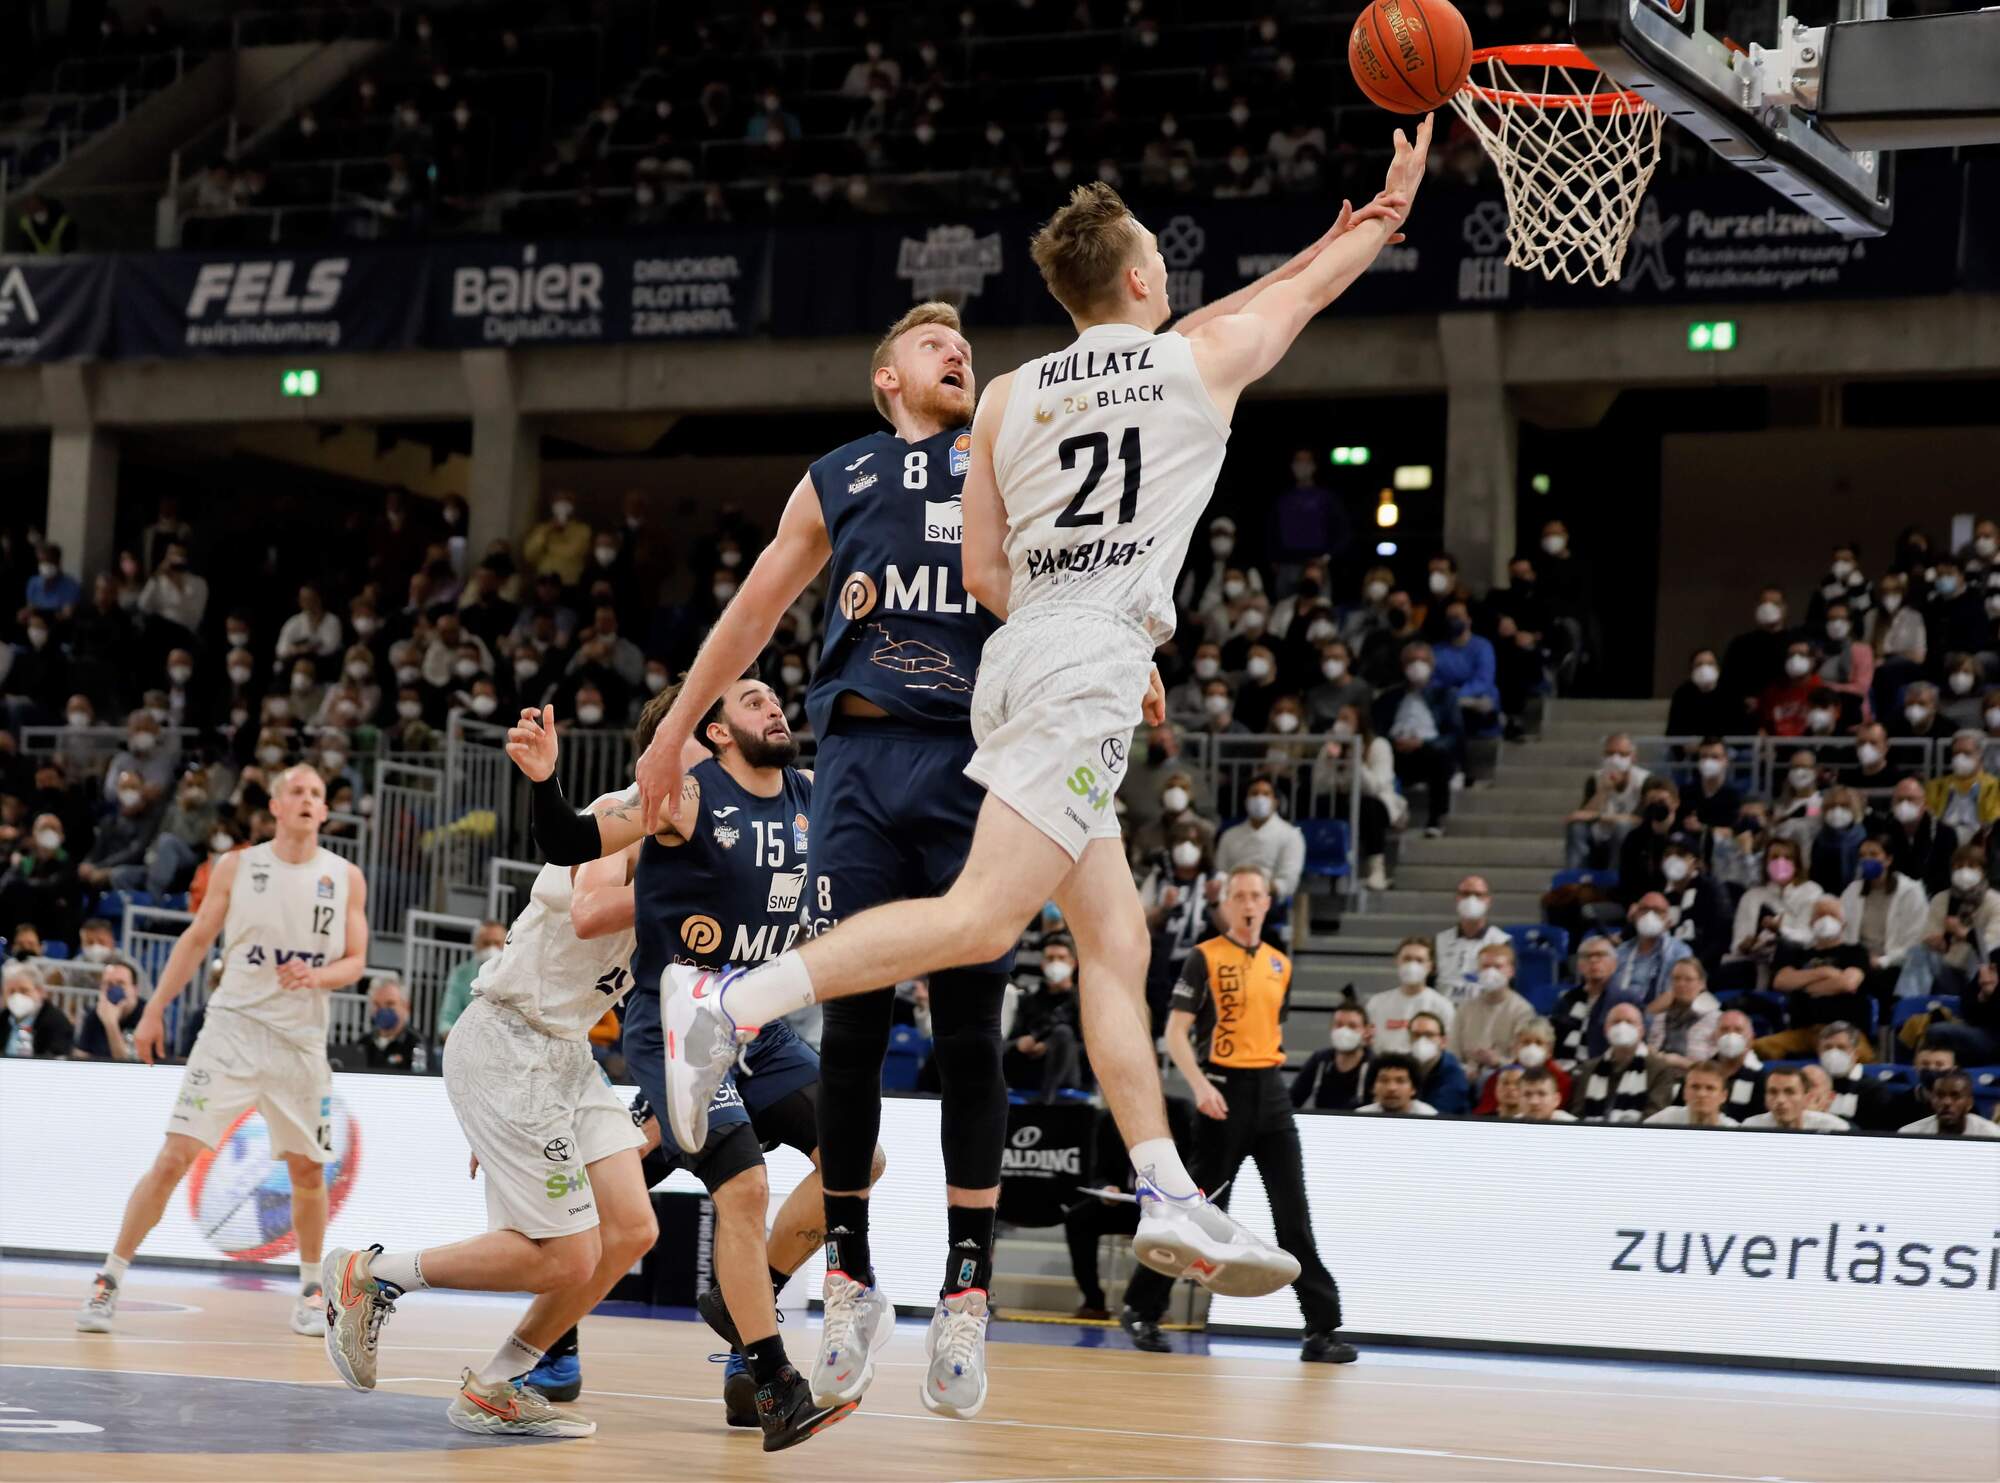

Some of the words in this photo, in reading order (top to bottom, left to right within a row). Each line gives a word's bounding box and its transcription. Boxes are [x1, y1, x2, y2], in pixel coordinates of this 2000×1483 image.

[186, 258, 349, 318] FELS
[1096, 384, 1164, 408] BLACK
[903, 451, 928, 490] 8
[1054, 426, 1143, 527] 21
[752, 821, 785, 867] 15
[769, 895, 797, 909] SNP
[816, 875, 832, 911] 8
[312, 905, 334, 935] 12
[1214, 964, 1240, 1059] GYMPER
[1001, 1147, 1081, 1175] ALDING
[1610, 1221, 2000, 1292] zuverlässi
